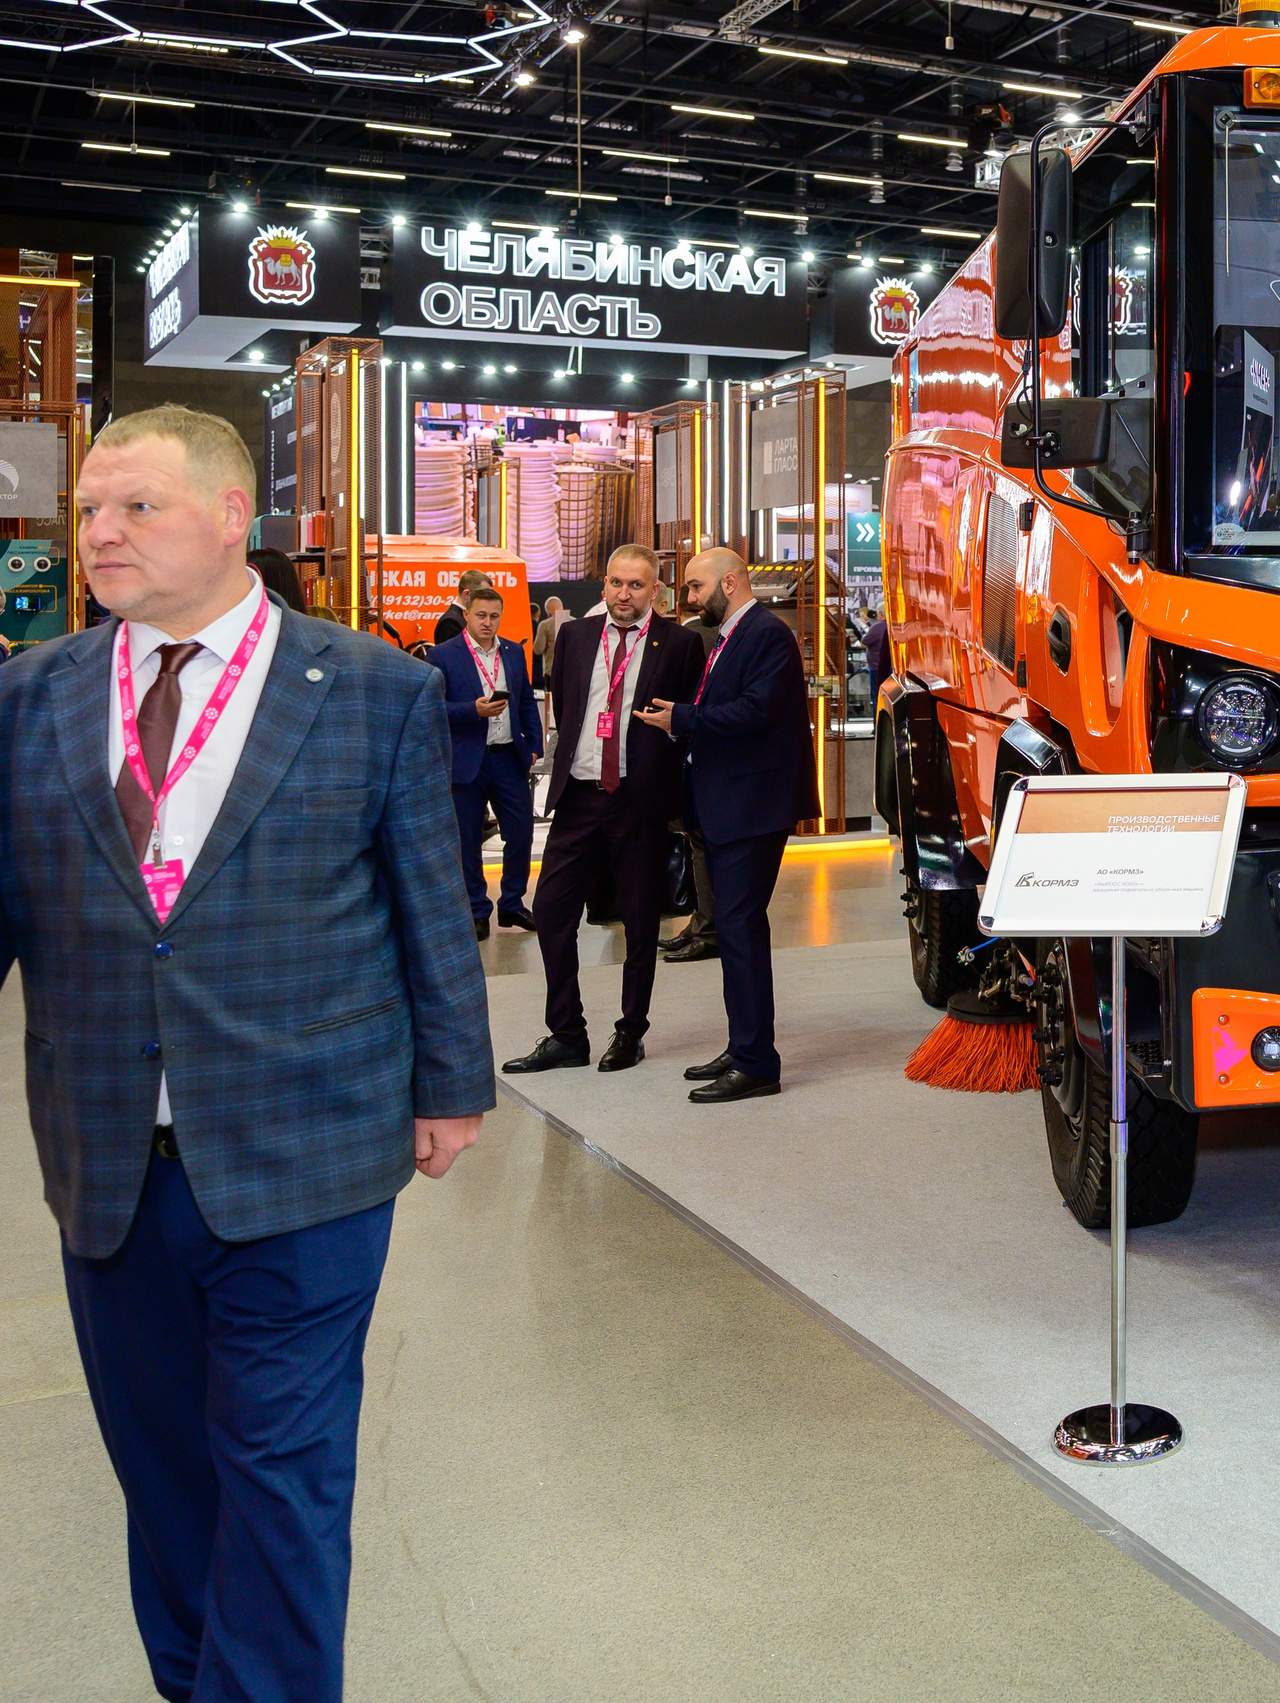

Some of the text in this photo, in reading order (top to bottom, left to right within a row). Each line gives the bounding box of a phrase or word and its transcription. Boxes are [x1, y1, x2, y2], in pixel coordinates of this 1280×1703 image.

[421, 226, 787, 296] ЧЕЛЯБИНСКАЯ
[420, 282, 661, 339] ОБЛАСТЬ
[774, 436, 798, 455] ЛАРТА
[774, 454, 798, 473] ГЛАСС
[1107, 825, 1175, 833] ТЕХНОЛОГИИ
[1108, 815, 1220, 824] ПРОИЗВОДСТВЕННЫЕ
[1032, 879, 1080, 887] КОРМЗ
